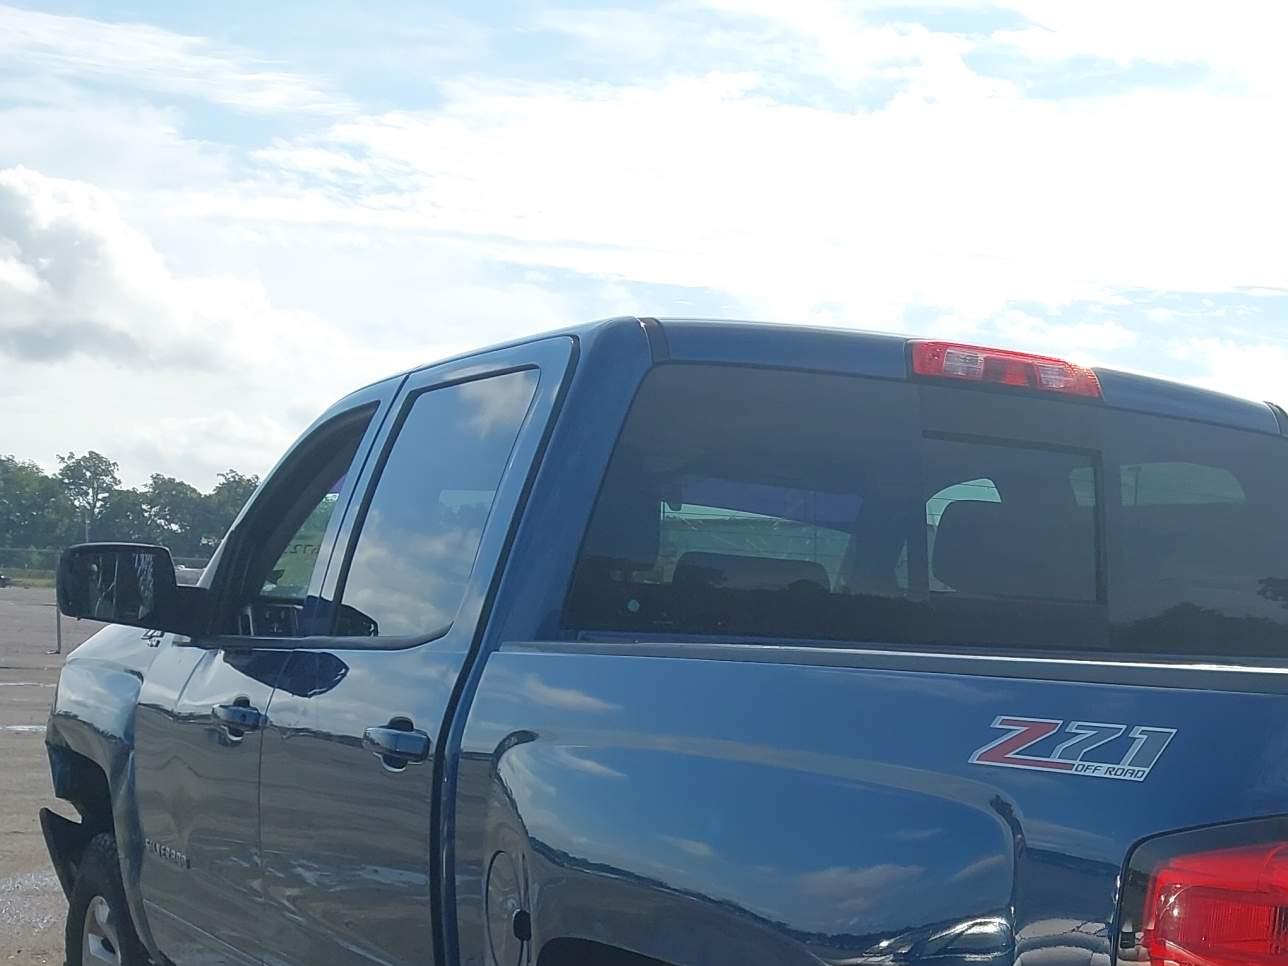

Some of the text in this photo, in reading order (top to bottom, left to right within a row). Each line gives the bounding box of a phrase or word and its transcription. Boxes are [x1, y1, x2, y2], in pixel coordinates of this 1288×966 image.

[968, 715, 1178, 775] Z71
[1074, 763, 1146, 779] OFF ROAD
